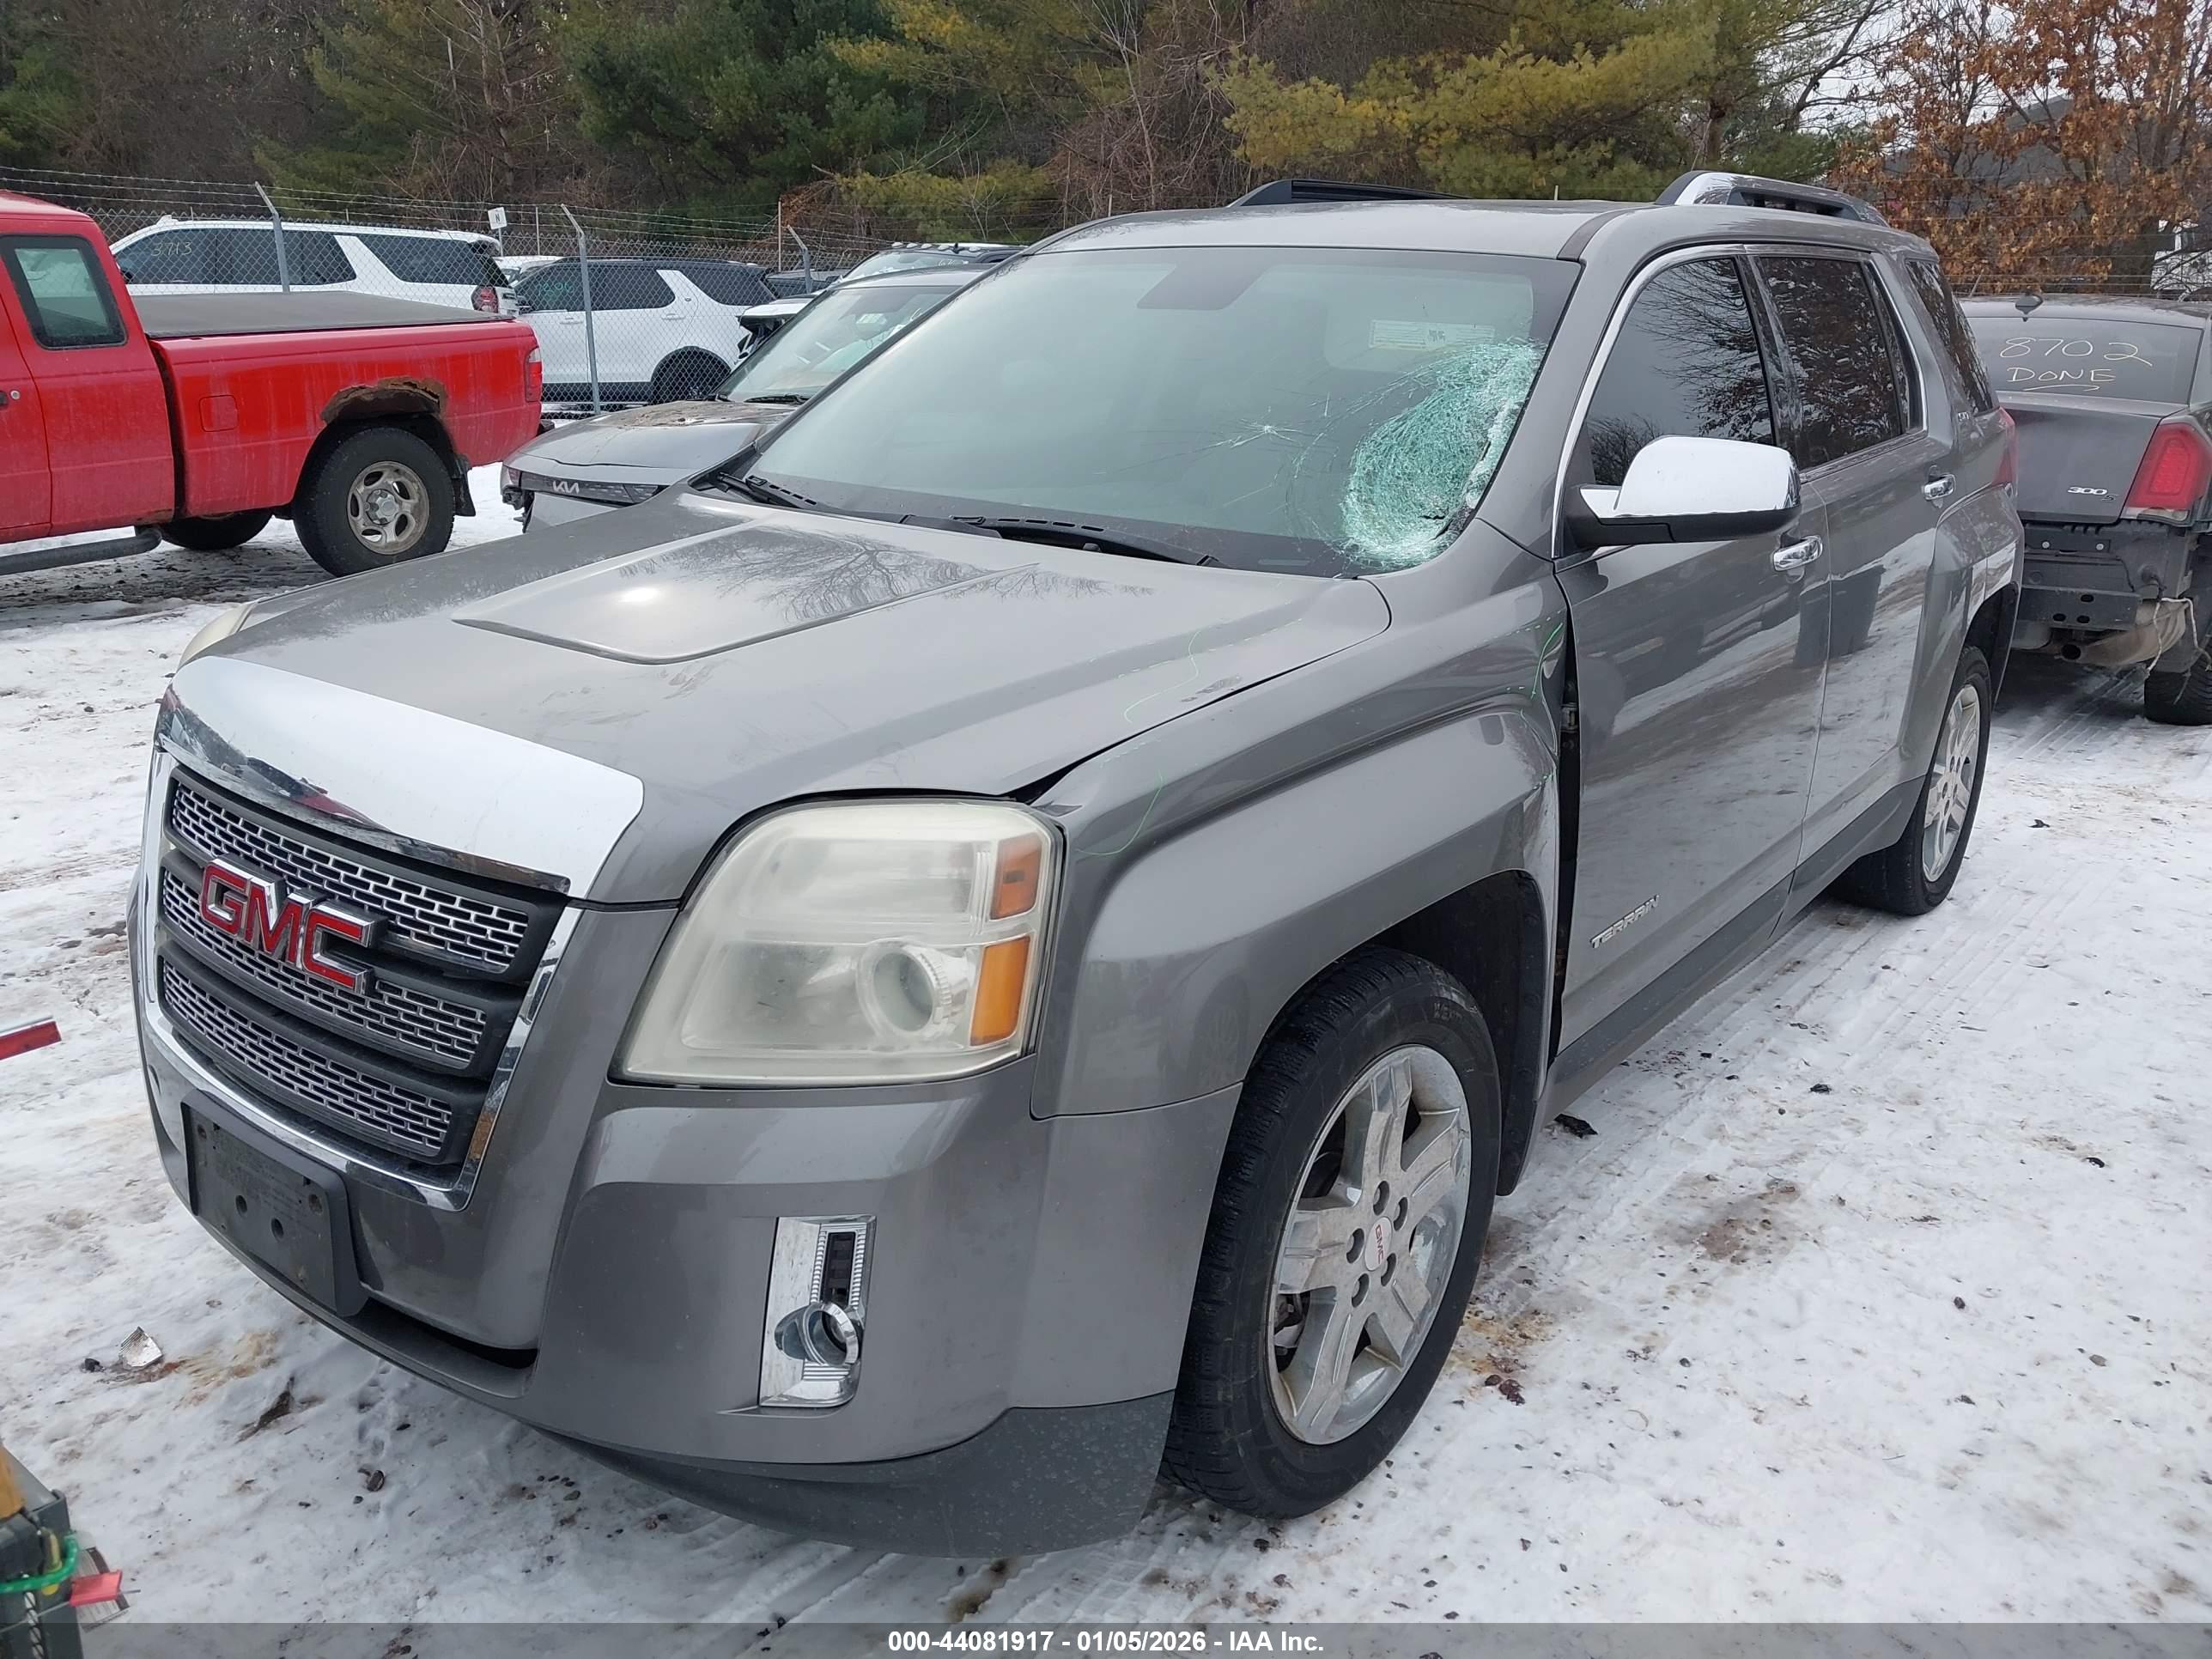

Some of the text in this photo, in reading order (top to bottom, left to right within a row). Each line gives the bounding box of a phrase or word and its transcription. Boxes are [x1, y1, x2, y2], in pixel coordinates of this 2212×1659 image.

[151, 240, 192, 256] 3713
[1999, 337, 2154, 368] 8702
[2006, 367, 2117, 382] DONE
[552, 480, 580, 495] KIA
[2067, 486, 2108, 495] 300
[199, 858, 375, 994] GMC
[1590, 894, 1660, 949] TERRAIN
[1375, 1224, 1384, 1265] GMC
